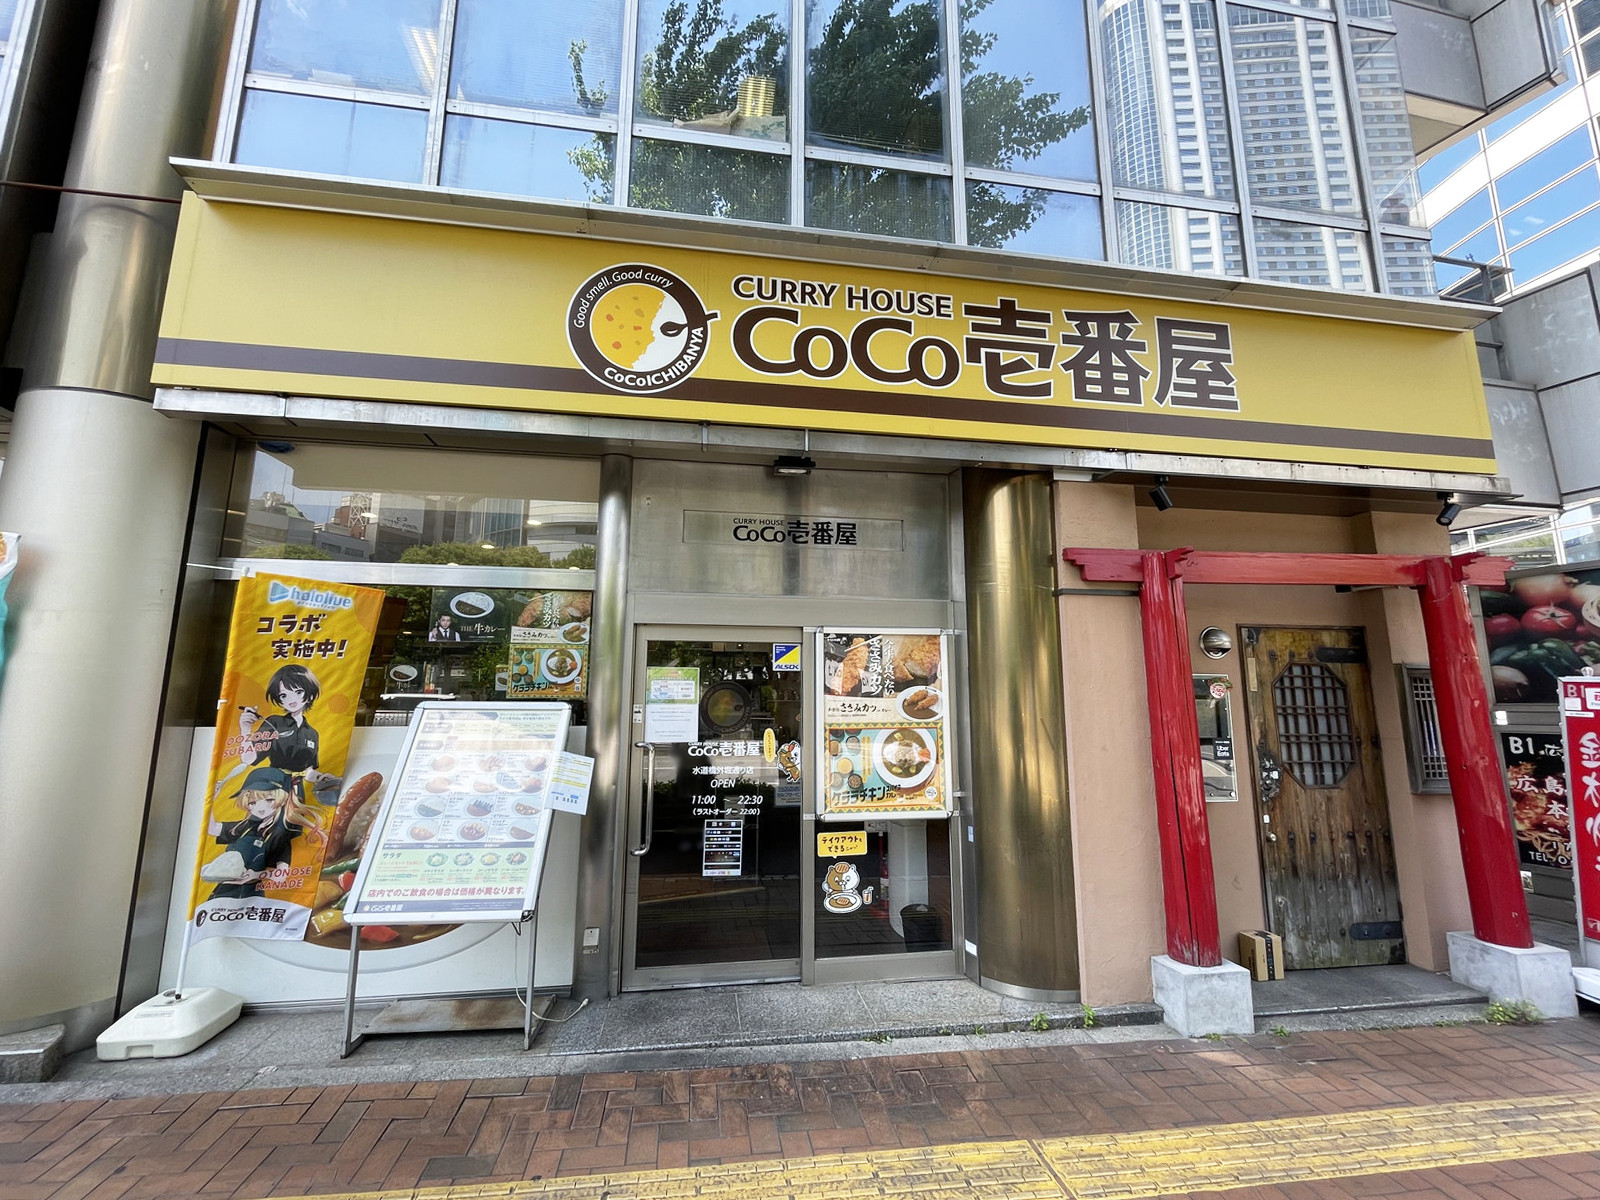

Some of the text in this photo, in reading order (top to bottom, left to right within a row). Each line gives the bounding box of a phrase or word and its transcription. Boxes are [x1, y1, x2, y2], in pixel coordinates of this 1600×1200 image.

[573, 268, 674, 328] Good smell. Good curry
[732, 274, 954, 320] CURRY HOUSE
[603, 326, 704, 387] CoCoICHIBANYA
[732, 297, 1241, 412] CoCo壱番屋
[733, 517, 785, 526] CURRY HOUSE
[733, 519, 858, 546] CoCo壱番屋
[290, 586, 352, 608] hololive
[257, 613, 327, 634] コラボ
[1567, 684, 1586, 699] B1
[226, 730, 280, 746] OOZORA
[223, 742, 272, 758] SUBARU
[687, 740, 761, 757] CoCo壱番屋
[710, 779, 736, 788] OPEN
[692, 795, 717, 805] 11:00
[737, 795, 763, 805] 22:30
[258, 866, 313, 880] OTONOSE
[255, 878, 304, 891] KANADE
[209, 905, 287, 923] CoCo壱番屋
